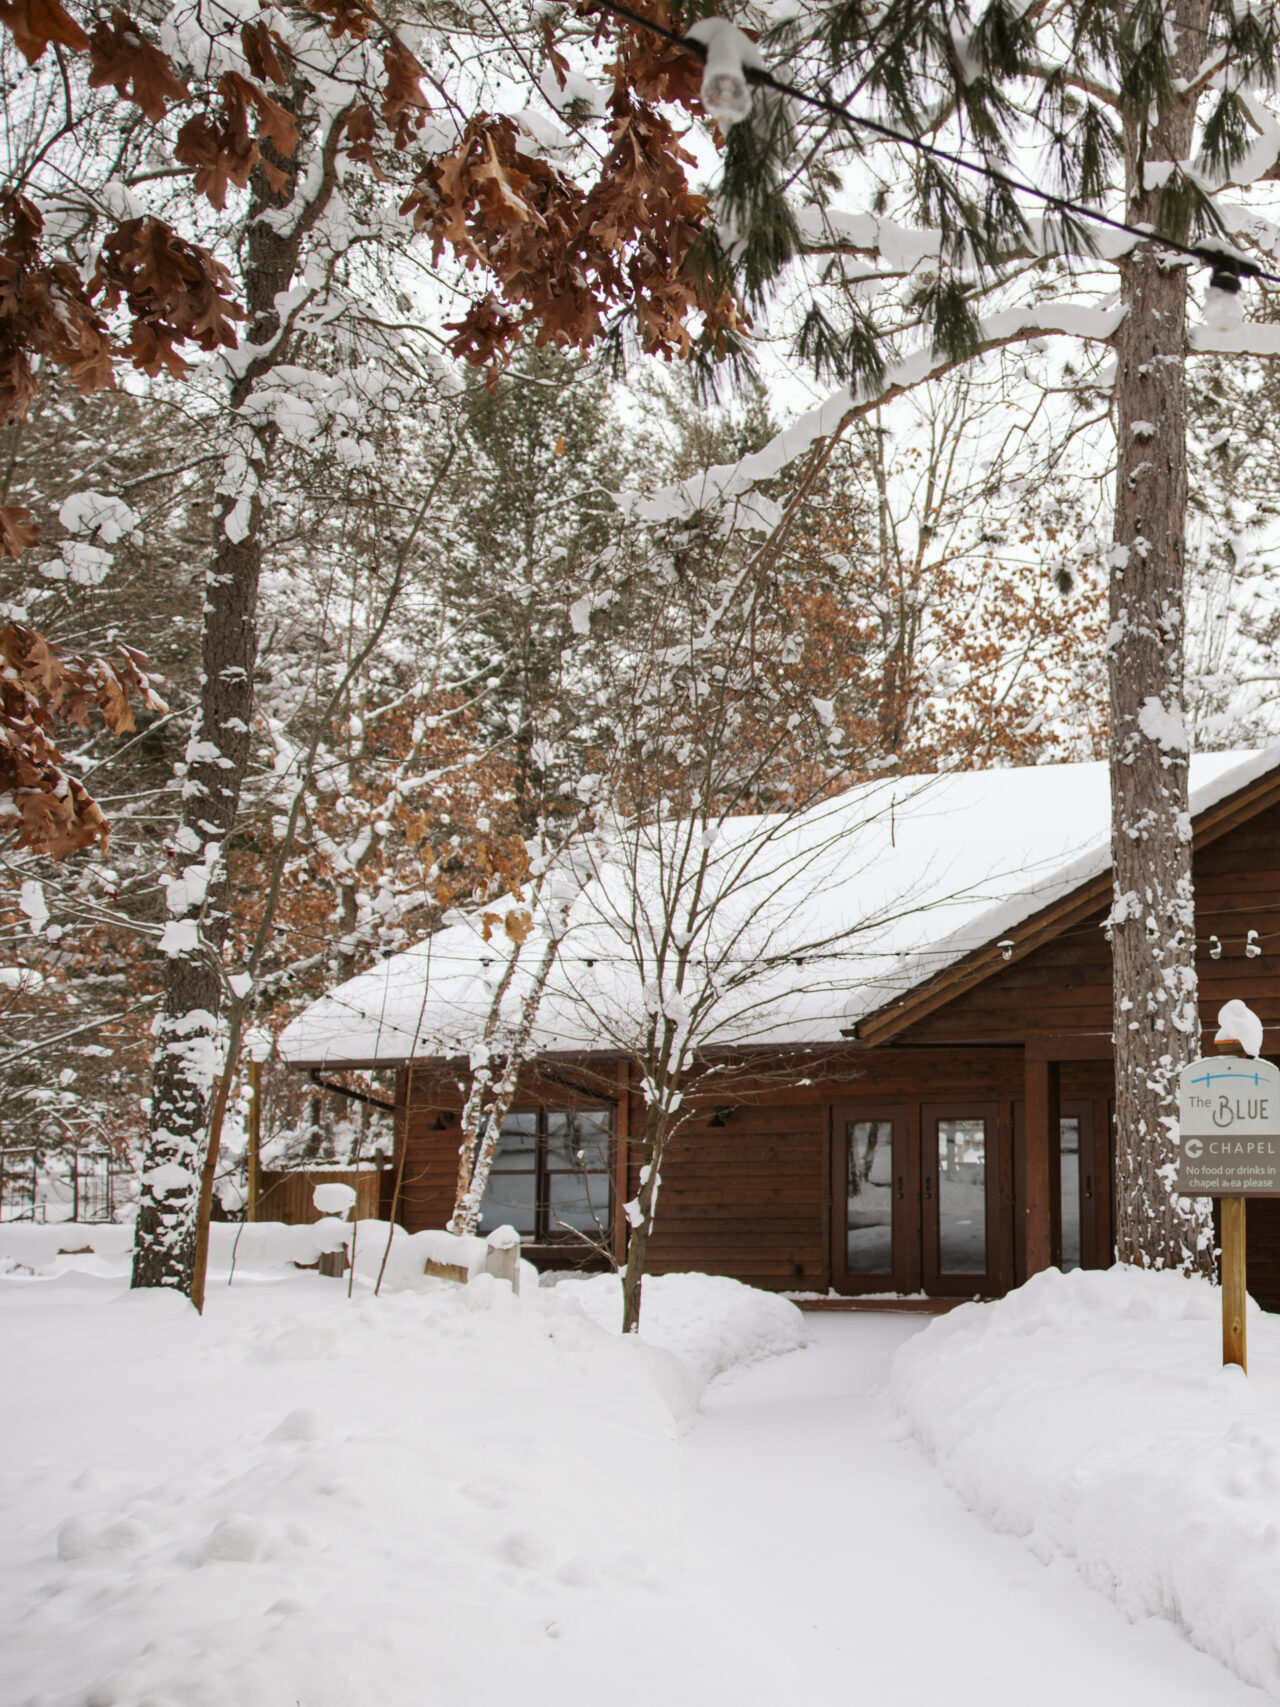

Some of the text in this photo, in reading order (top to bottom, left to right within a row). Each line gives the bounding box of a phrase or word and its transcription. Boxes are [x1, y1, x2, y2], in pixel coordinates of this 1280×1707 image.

[1188, 1095, 1269, 1128] The BLUE
[1209, 1142, 1275, 1154] CHAPEL
[1186, 1165, 1276, 1175] No food or drinks in
[1189, 1178, 1219, 1189] chapel
[1244, 1178, 1273, 1189] please
